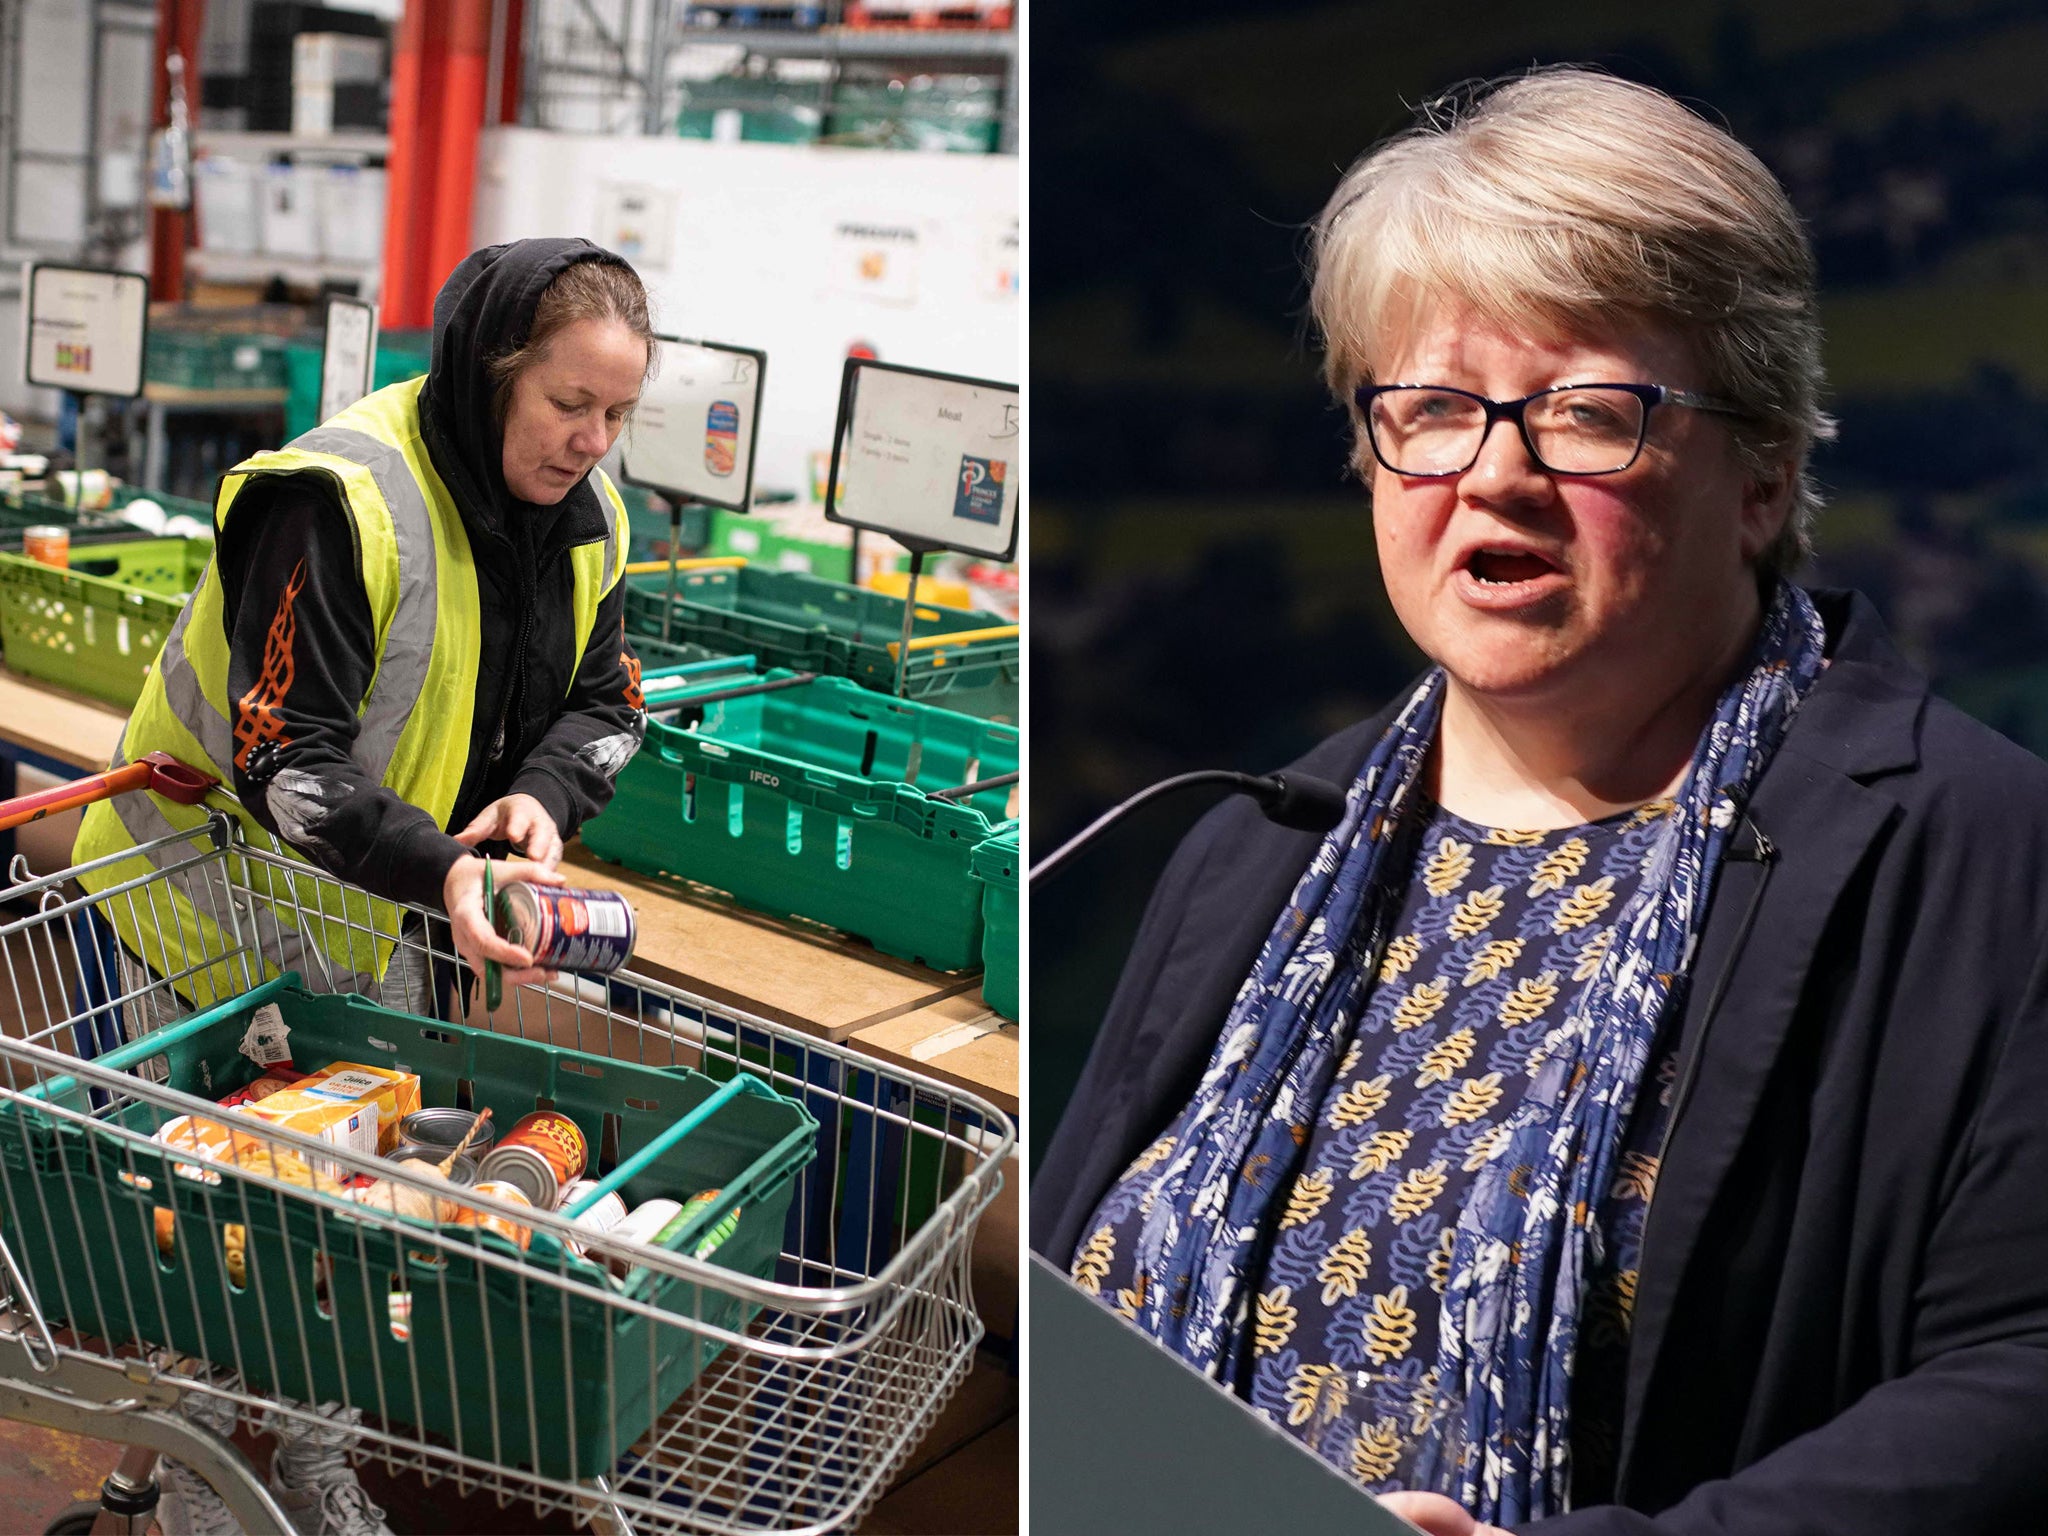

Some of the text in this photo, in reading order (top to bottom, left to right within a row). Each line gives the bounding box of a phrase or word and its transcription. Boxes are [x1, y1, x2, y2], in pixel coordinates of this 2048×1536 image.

[937, 407, 963, 422] Meat
[750, 770, 779, 787] IFCO
[344, 1075, 372, 1086] Juice
